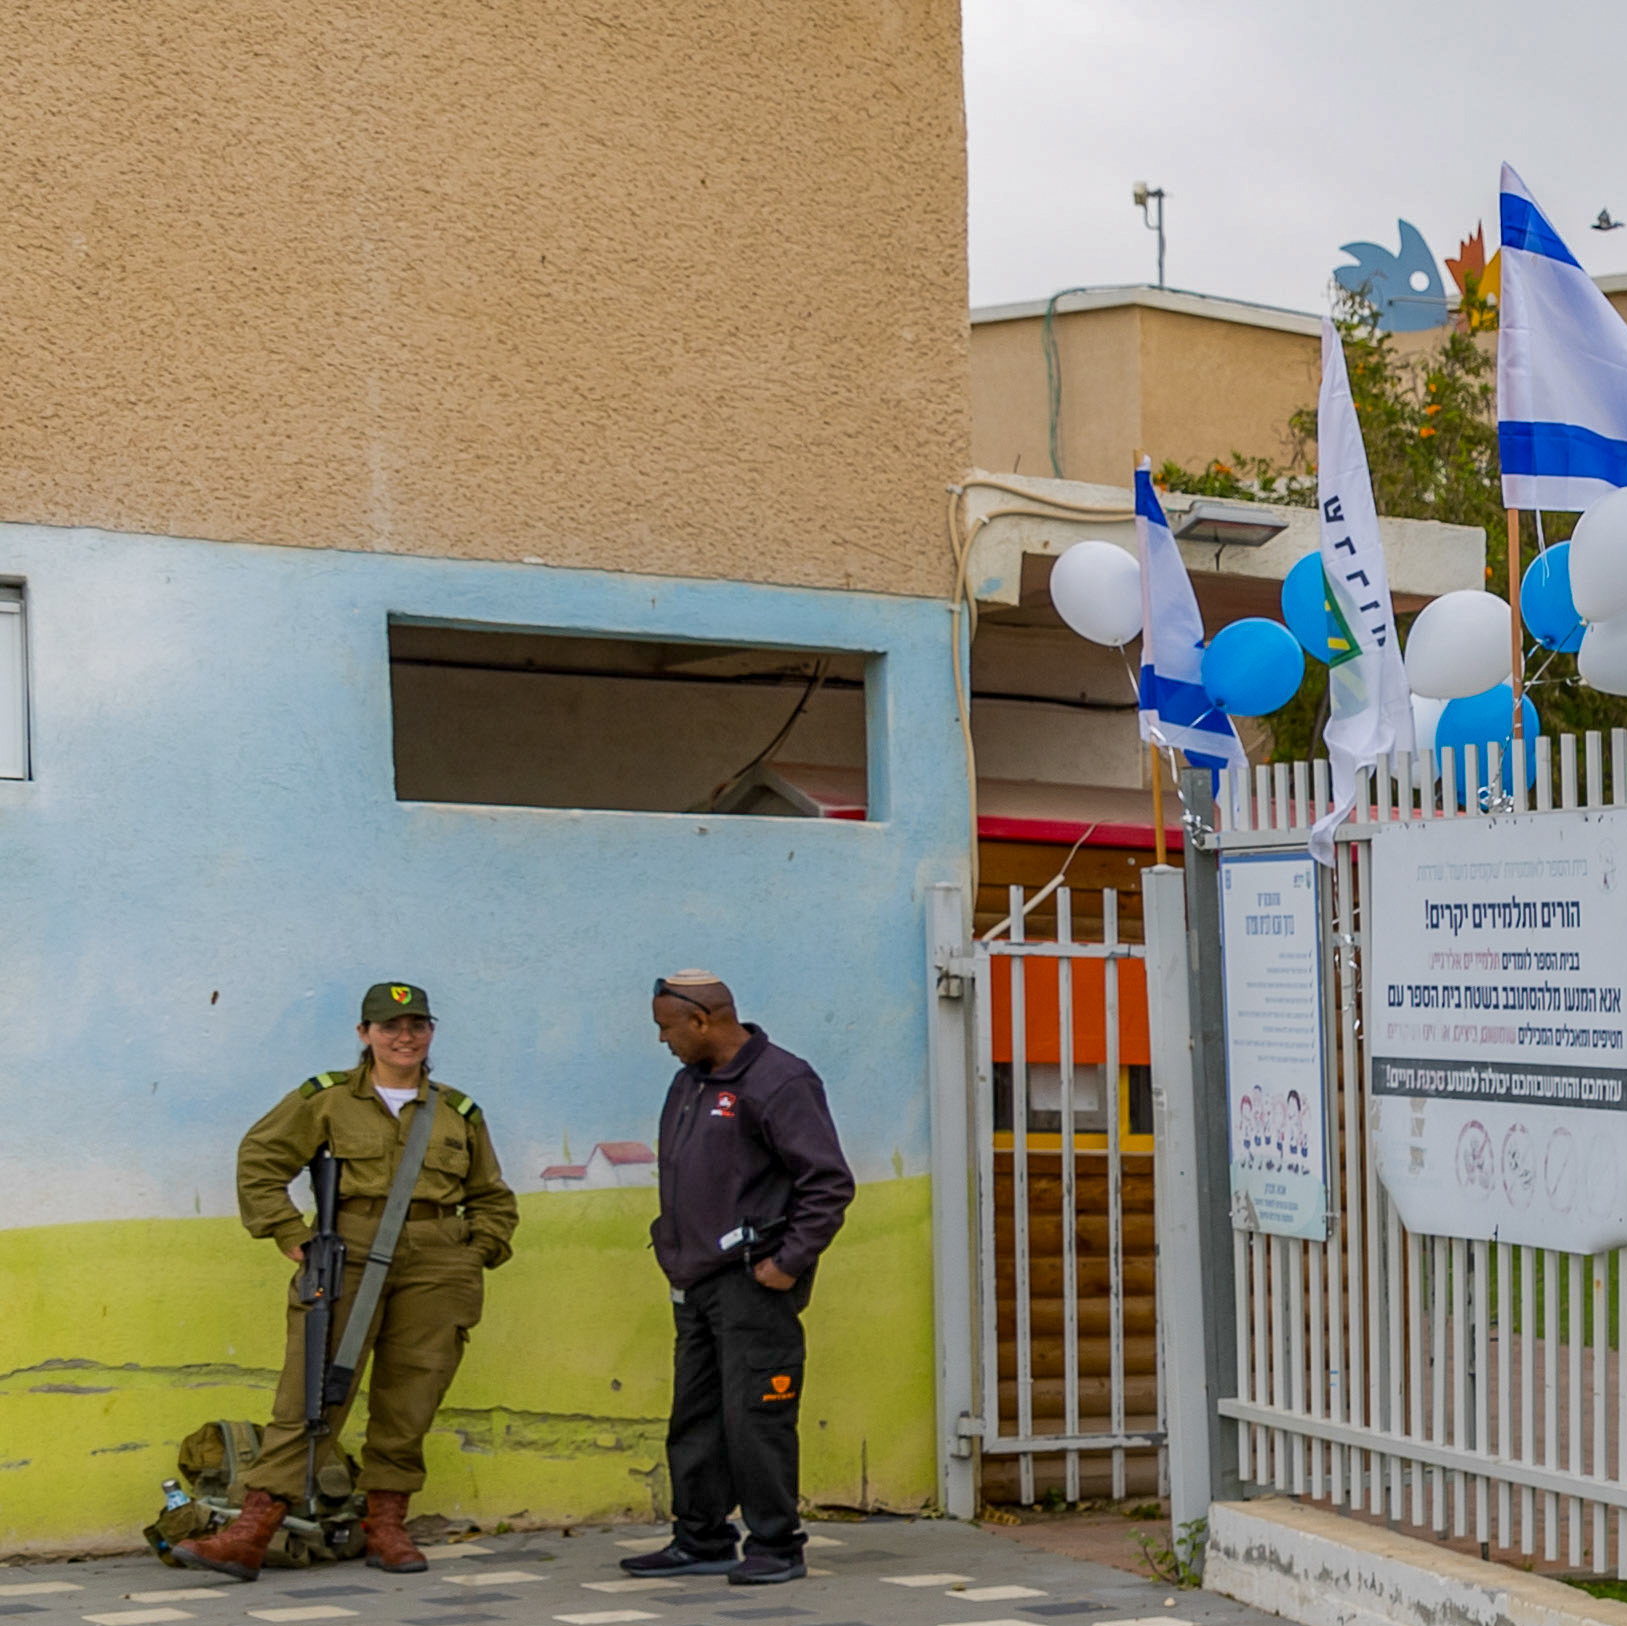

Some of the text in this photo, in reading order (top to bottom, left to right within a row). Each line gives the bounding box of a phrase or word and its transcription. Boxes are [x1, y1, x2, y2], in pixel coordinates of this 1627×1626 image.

[1425, 895, 1581, 936] הורים ותלמידים יקרים!
[1502, 947, 1532, 971] לומדים
[1533, 952, 1558, 971] הספר
[1559, 952, 1581, 971] בבית
[1388, 980, 1622, 1013] אנא המנעו מלהסתובב בשטח בית הספר עם
[1518, 1022, 1553, 1046] המכילים
[1555, 1023, 1591, 1048] ומאכלים
[1592, 1029, 1623, 1049] חטיפים
[1386, 1064, 1622, 1102] עזרתכם והתחשבותכם יכולה למנוע סכנת חיים!
